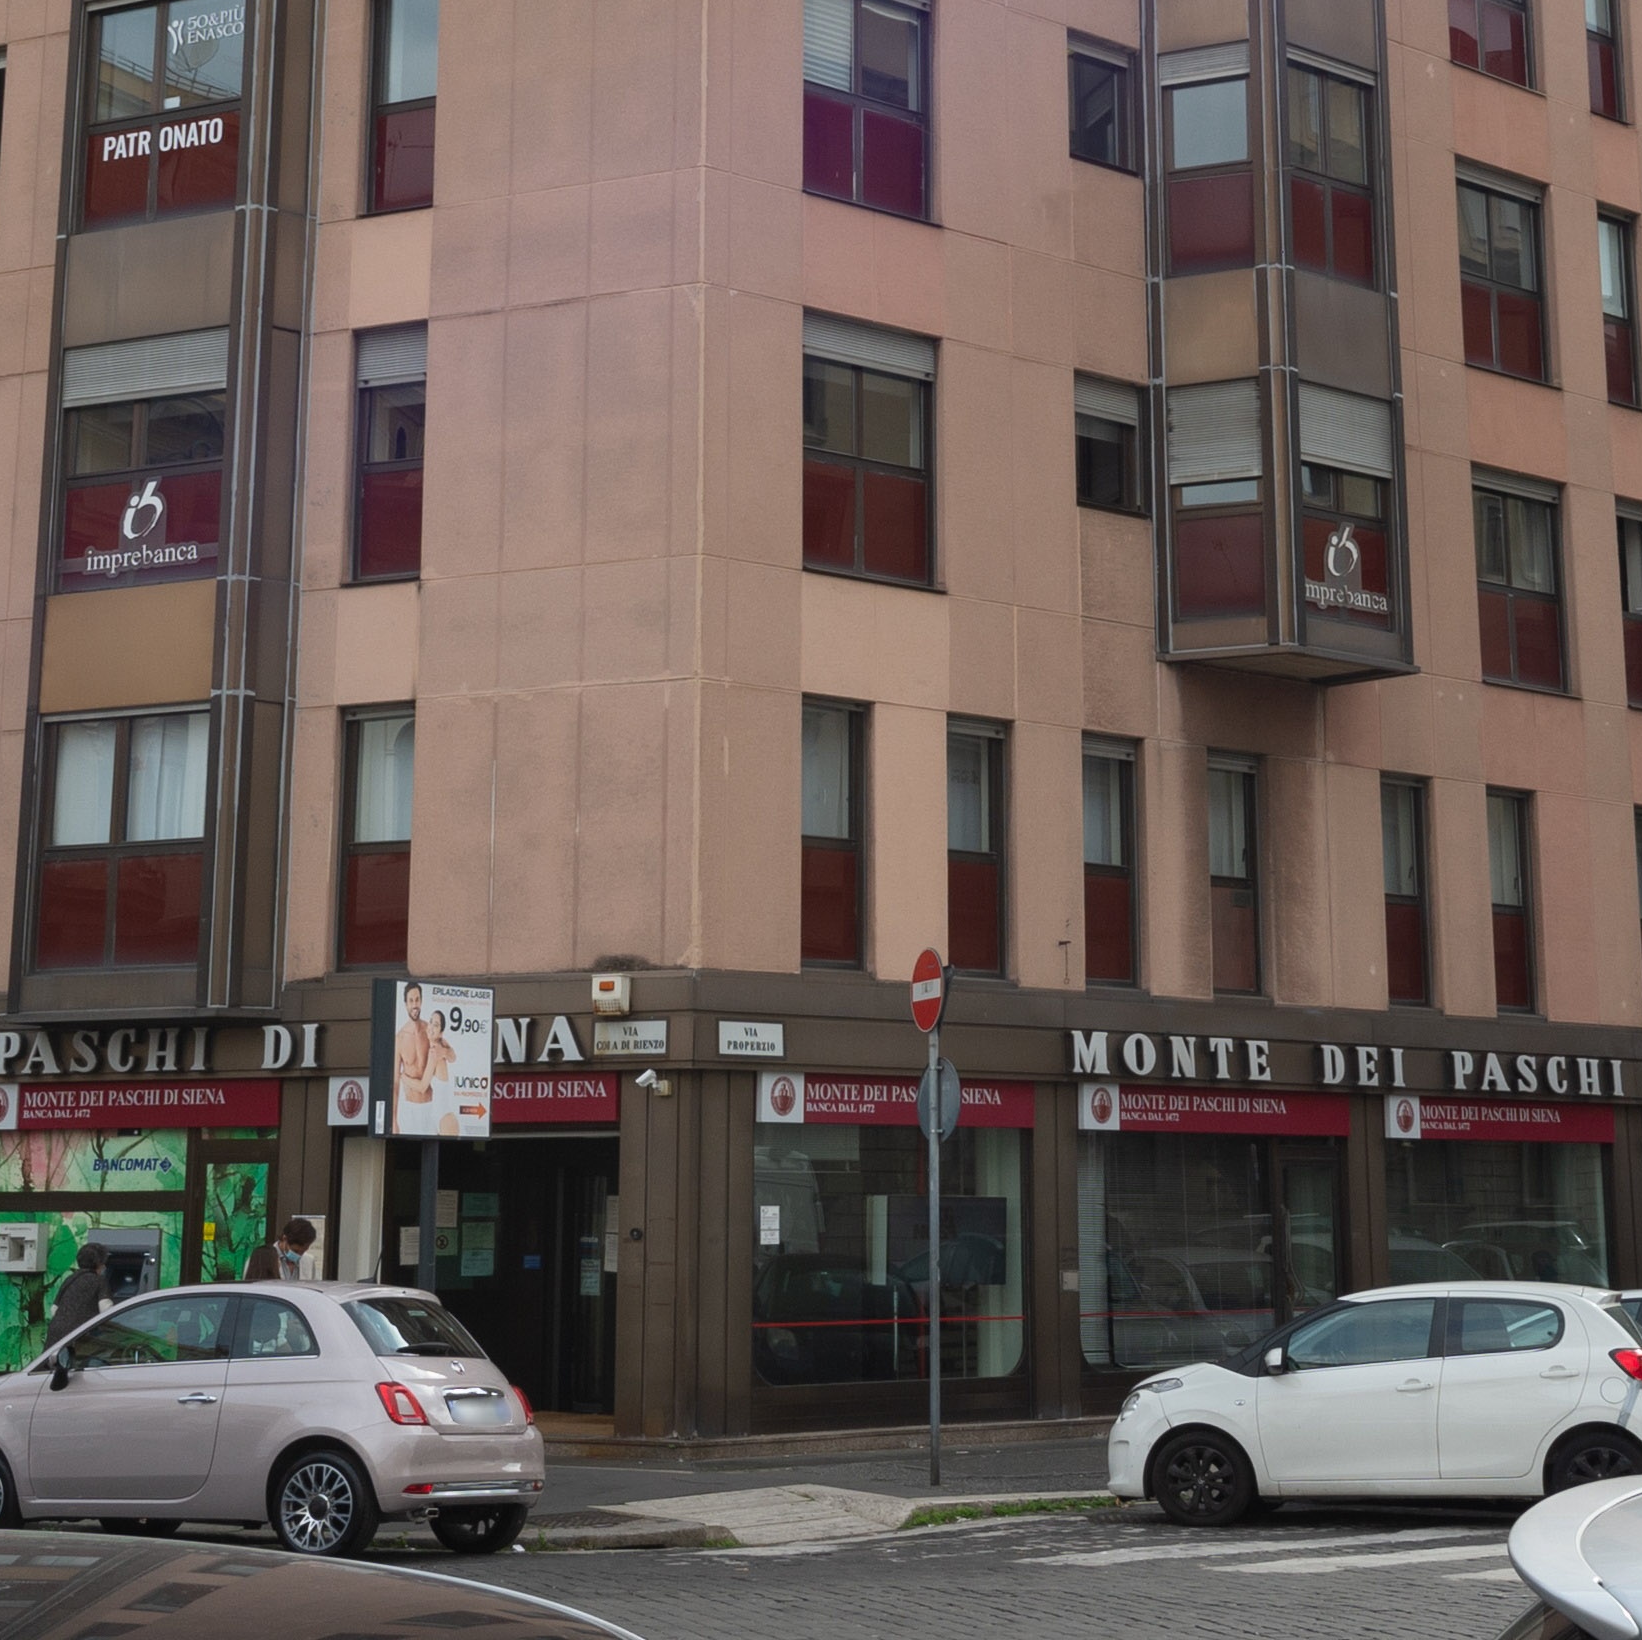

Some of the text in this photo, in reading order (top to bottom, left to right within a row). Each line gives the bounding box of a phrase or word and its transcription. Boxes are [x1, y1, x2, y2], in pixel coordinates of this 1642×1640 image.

[188, 22, 245, 44] ENASCO
[86, 543, 198, 574] imprebanca
[1304, 583, 1389, 612] mprebanca
[623, 1026, 639, 1037] VIA
[744, 1027, 759, 1038] VIA
[260, 1023, 321, 1069] DI
[621, 1040, 631, 1050] DI
[633, 1039, 665, 1050] RIENZO
[727, 1040, 776, 1052] PROPERZIO
[1071, 1030, 1272, 1082] MONTE
[1320, 1044, 1406, 1088] DEI
[1451, 1050, 1624, 1097] PASCHI
[24, 1088, 226, 1108] MONTE DEI PASCHI DI SIENA
[493, 1080, 607, 1099] SCHI DI SIENA
[806, 1083, 1002, 1106] MONTE DEI PAS SIENA
[806, 1103, 875, 1114] BANCA DAL 1472
[1121, 1093, 1287, 1114] MONTE DEI PASCHI DI SIENA
[23, 1109, 91, 1119] BANCA DAL 1472
[1420, 1104, 1561, 1124] MONTE DEI PASCHI DI SIENA
[93, 1158, 160, 1172] BANCOMAT
